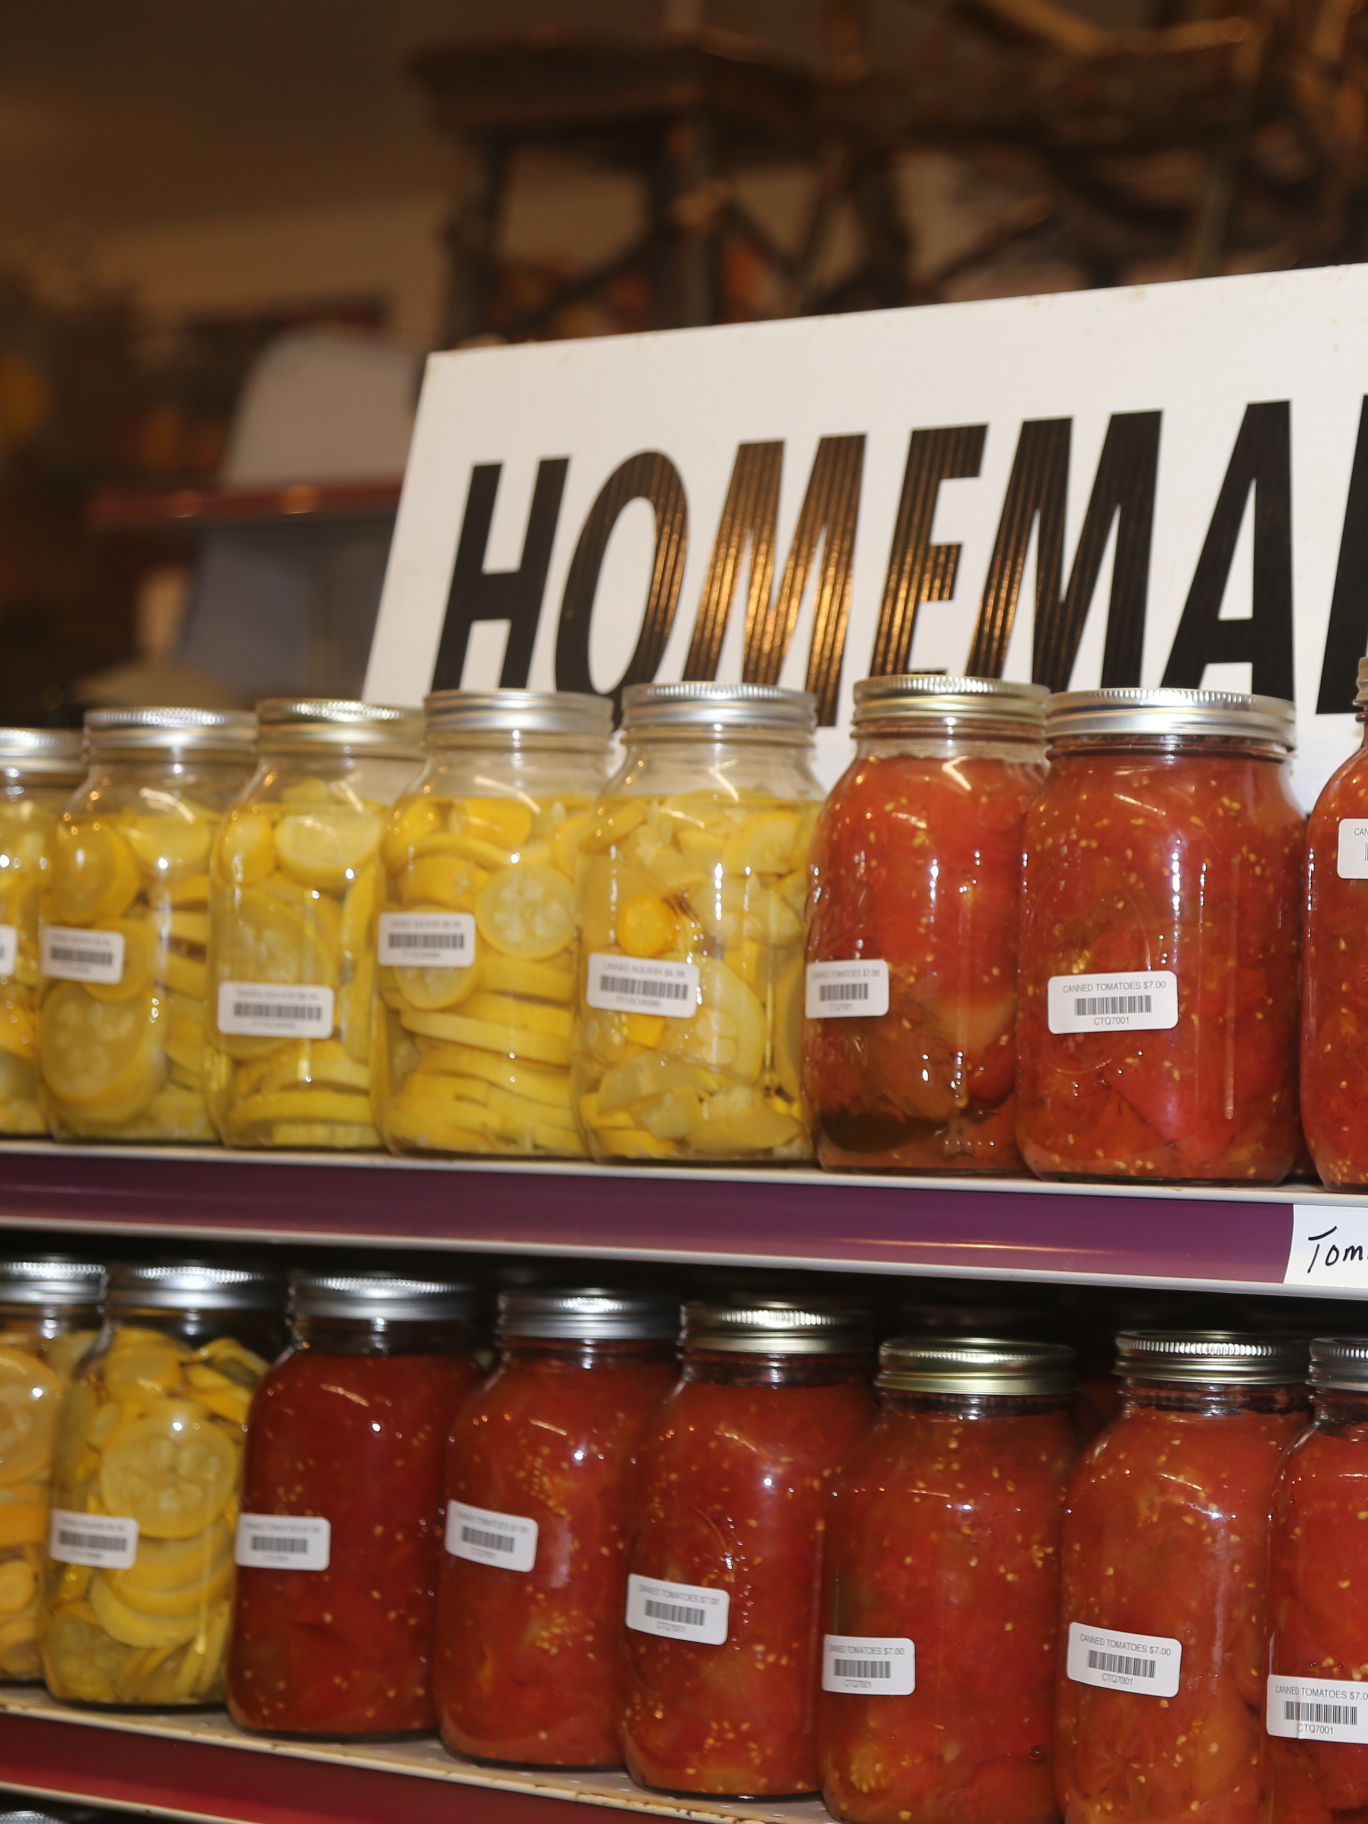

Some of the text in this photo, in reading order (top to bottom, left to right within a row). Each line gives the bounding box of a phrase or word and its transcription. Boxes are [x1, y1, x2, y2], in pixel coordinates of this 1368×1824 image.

[863, 968, 881, 977] $7.00
[1062, 980, 1167, 993] CANNED TOMATOES $7.00
[1094, 1016, 1130, 1026] CTQ7001
[847, 1645, 883, 1655] TOMATOES
[884, 1647, 905, 1656] $7.00
[1080, 1633, 1172, 1656] CANNED TOMATOES $7.00
[1102, 1672, 1133, 1685] CTQ7001
[1275, 1684, 1300, 1695] CANNED
[1301, 1687, 1347, 1700] TOMATOES
[1297, 1723, 1334, 1735] CTQ7001
